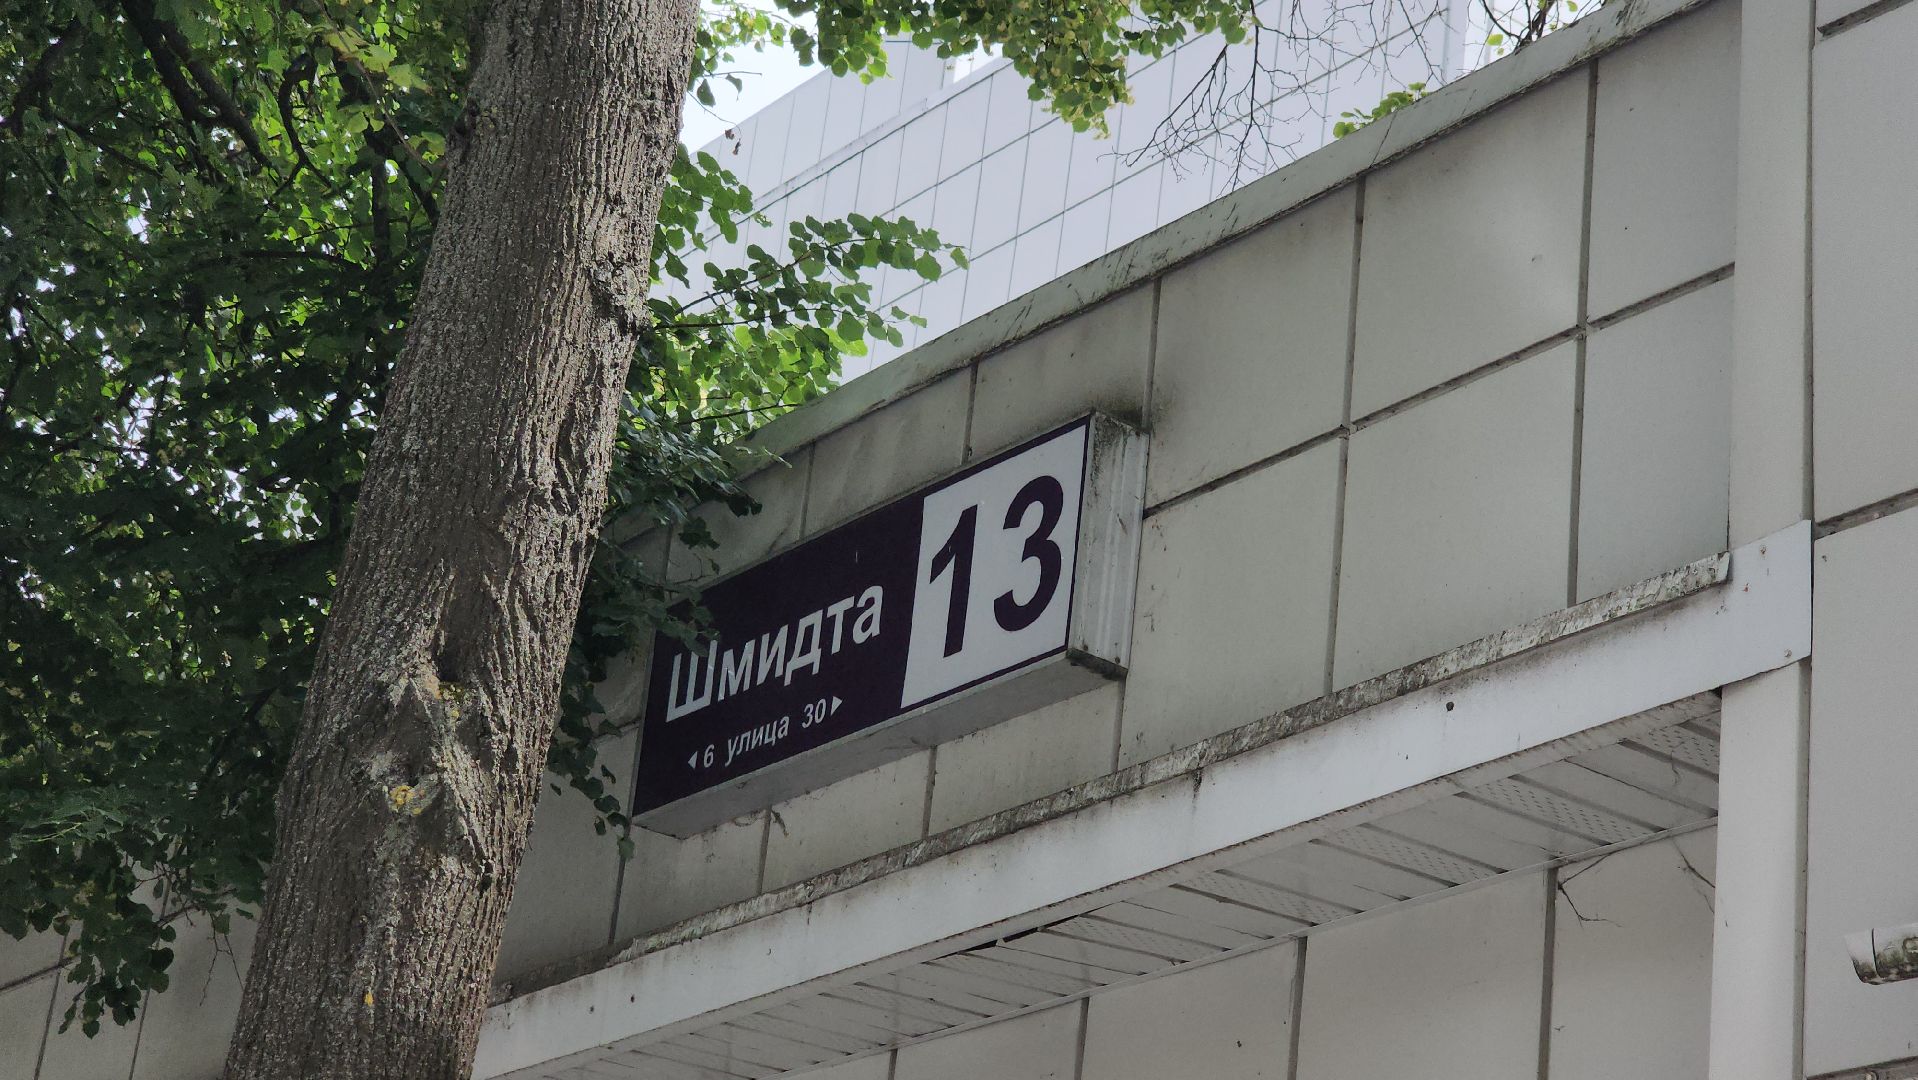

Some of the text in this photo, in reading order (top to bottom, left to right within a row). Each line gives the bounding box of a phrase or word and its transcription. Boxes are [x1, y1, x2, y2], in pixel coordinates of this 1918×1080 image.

[929, 475, 1064, 659] 13
[666, 585, 884, 723] Шмидта
[703, 698, 827, 768] 6 улица 30
